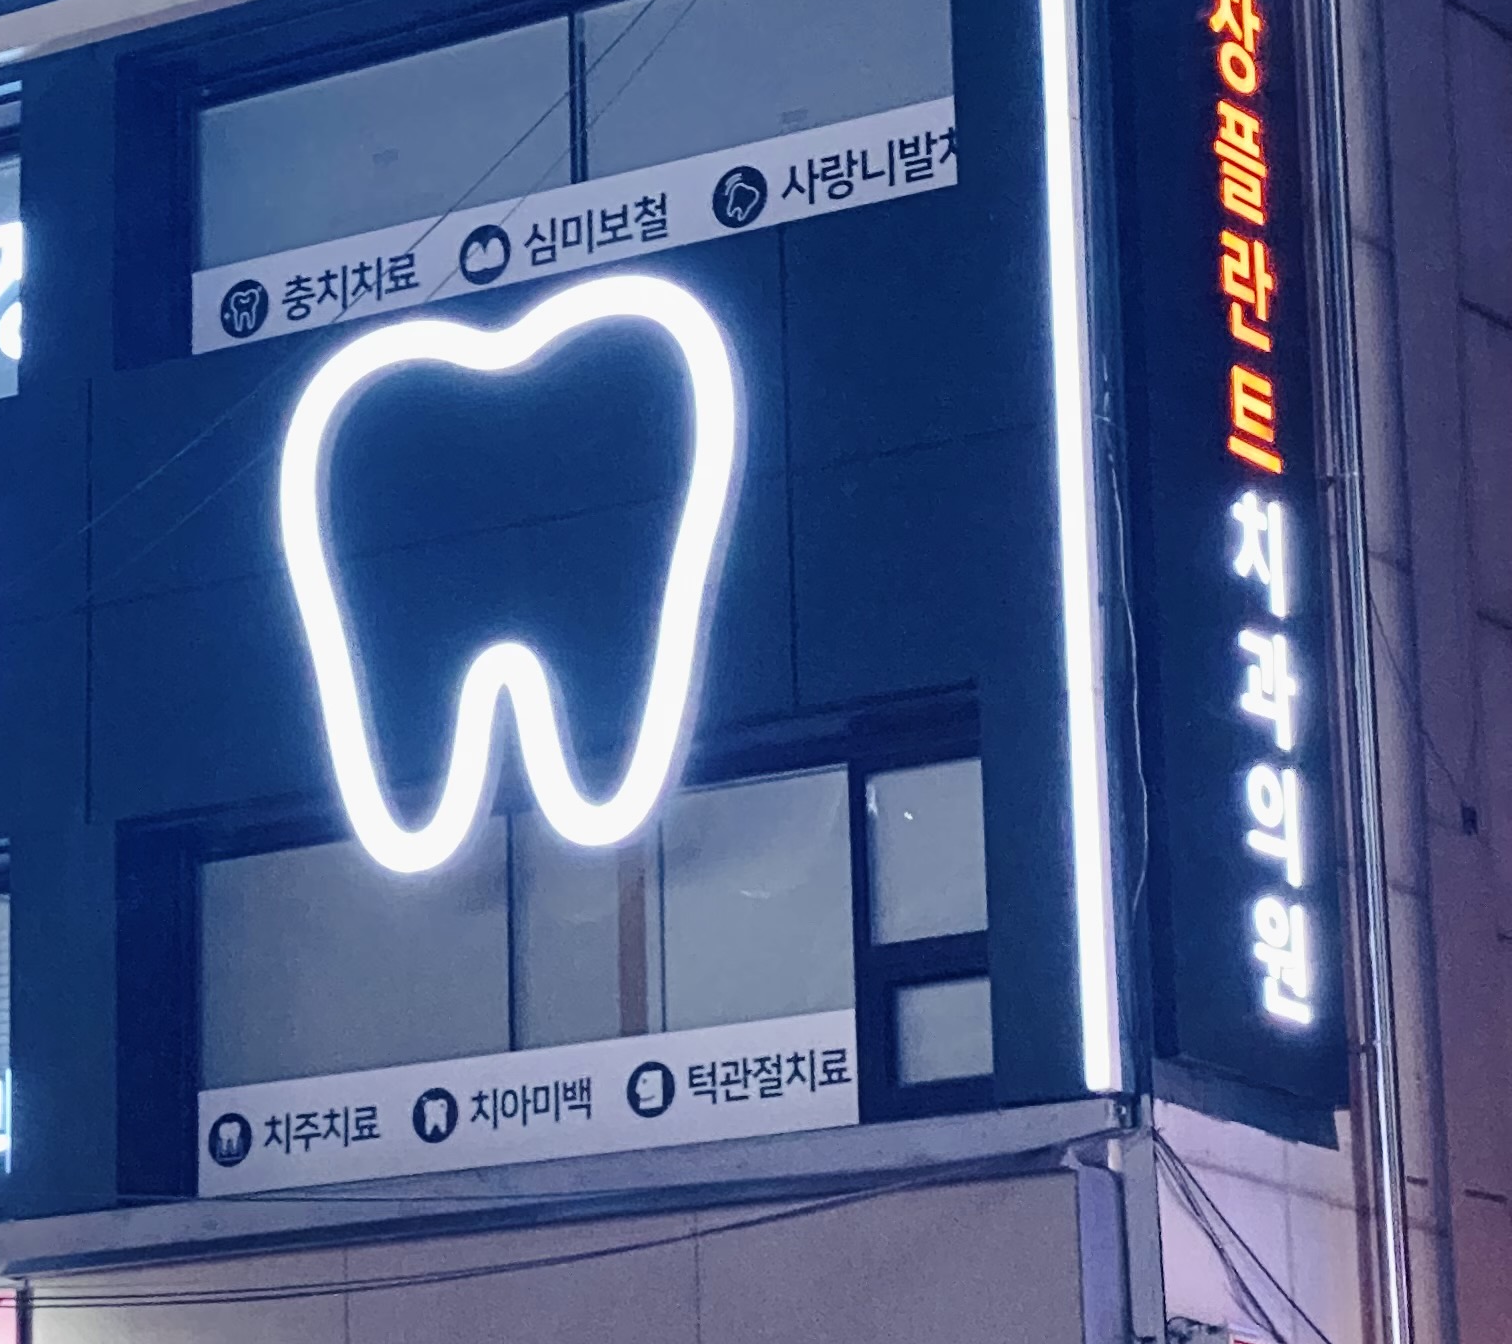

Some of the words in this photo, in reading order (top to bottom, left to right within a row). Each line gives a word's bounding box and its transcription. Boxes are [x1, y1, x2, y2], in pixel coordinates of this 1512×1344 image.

[281, 253, 420, 324] 충치치료
[522, 194, 669, 267] 심미보철
[263, 1104, 382, 1156] 치주치료
[470, 1075, 593, 1130] 치아미백
[686, 1048, 854, 1105] 턱관절치료
